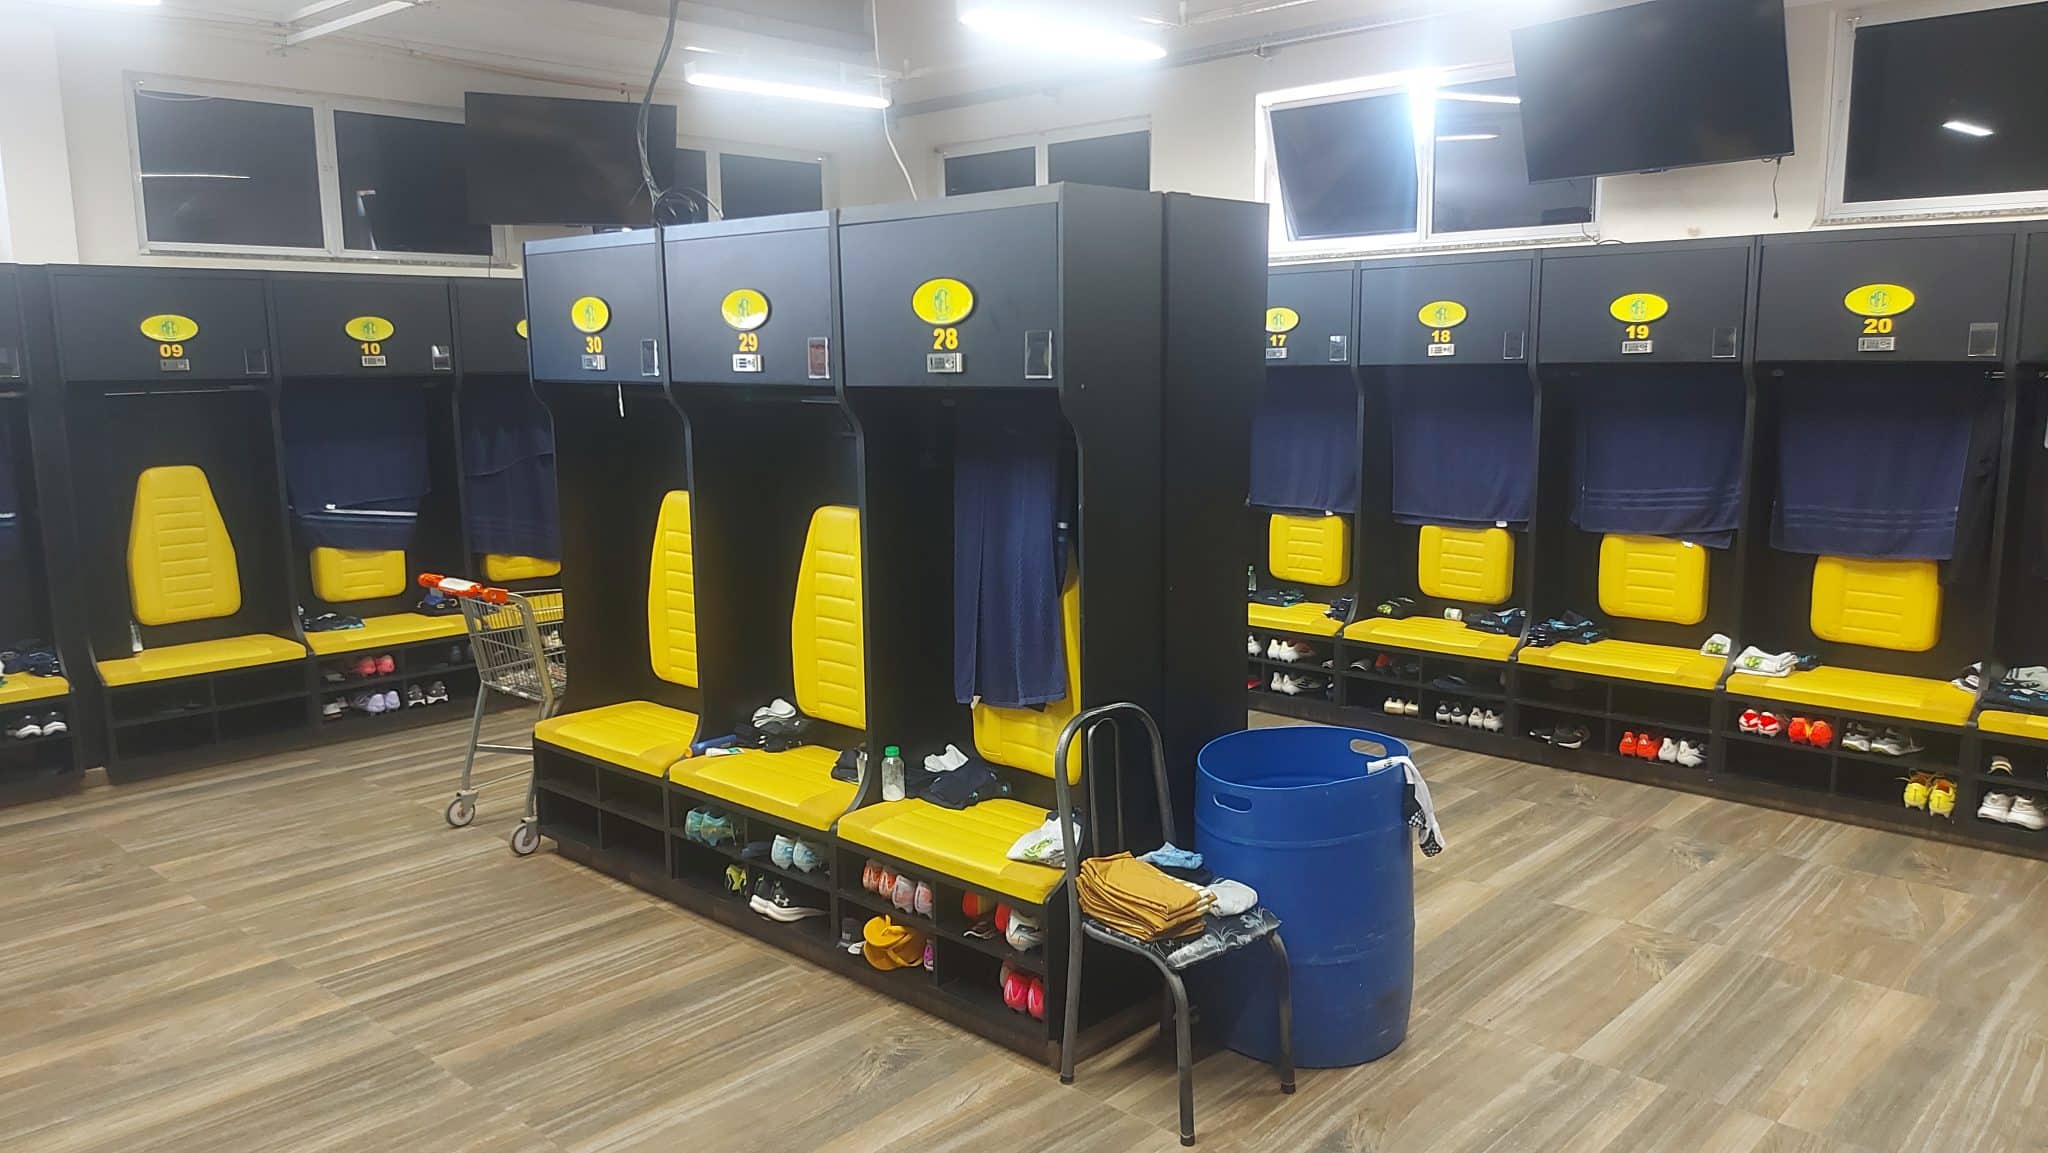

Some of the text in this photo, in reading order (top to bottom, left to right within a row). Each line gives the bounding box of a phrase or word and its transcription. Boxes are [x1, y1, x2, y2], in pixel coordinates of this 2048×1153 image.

[1625, 325, 1649, 339] 19
[1862, 318, 1893, 334] 20
[738, 332, 758, 352] 29
[933, 327, 959, 350] 28
[1270, 334, 1287, 347] 17
[1431, 329, 1451, 343] 18
[160, 343, 184, 358] 09
[361, 342, 381, 355] 10
[585, 335, 602, 354] 30
